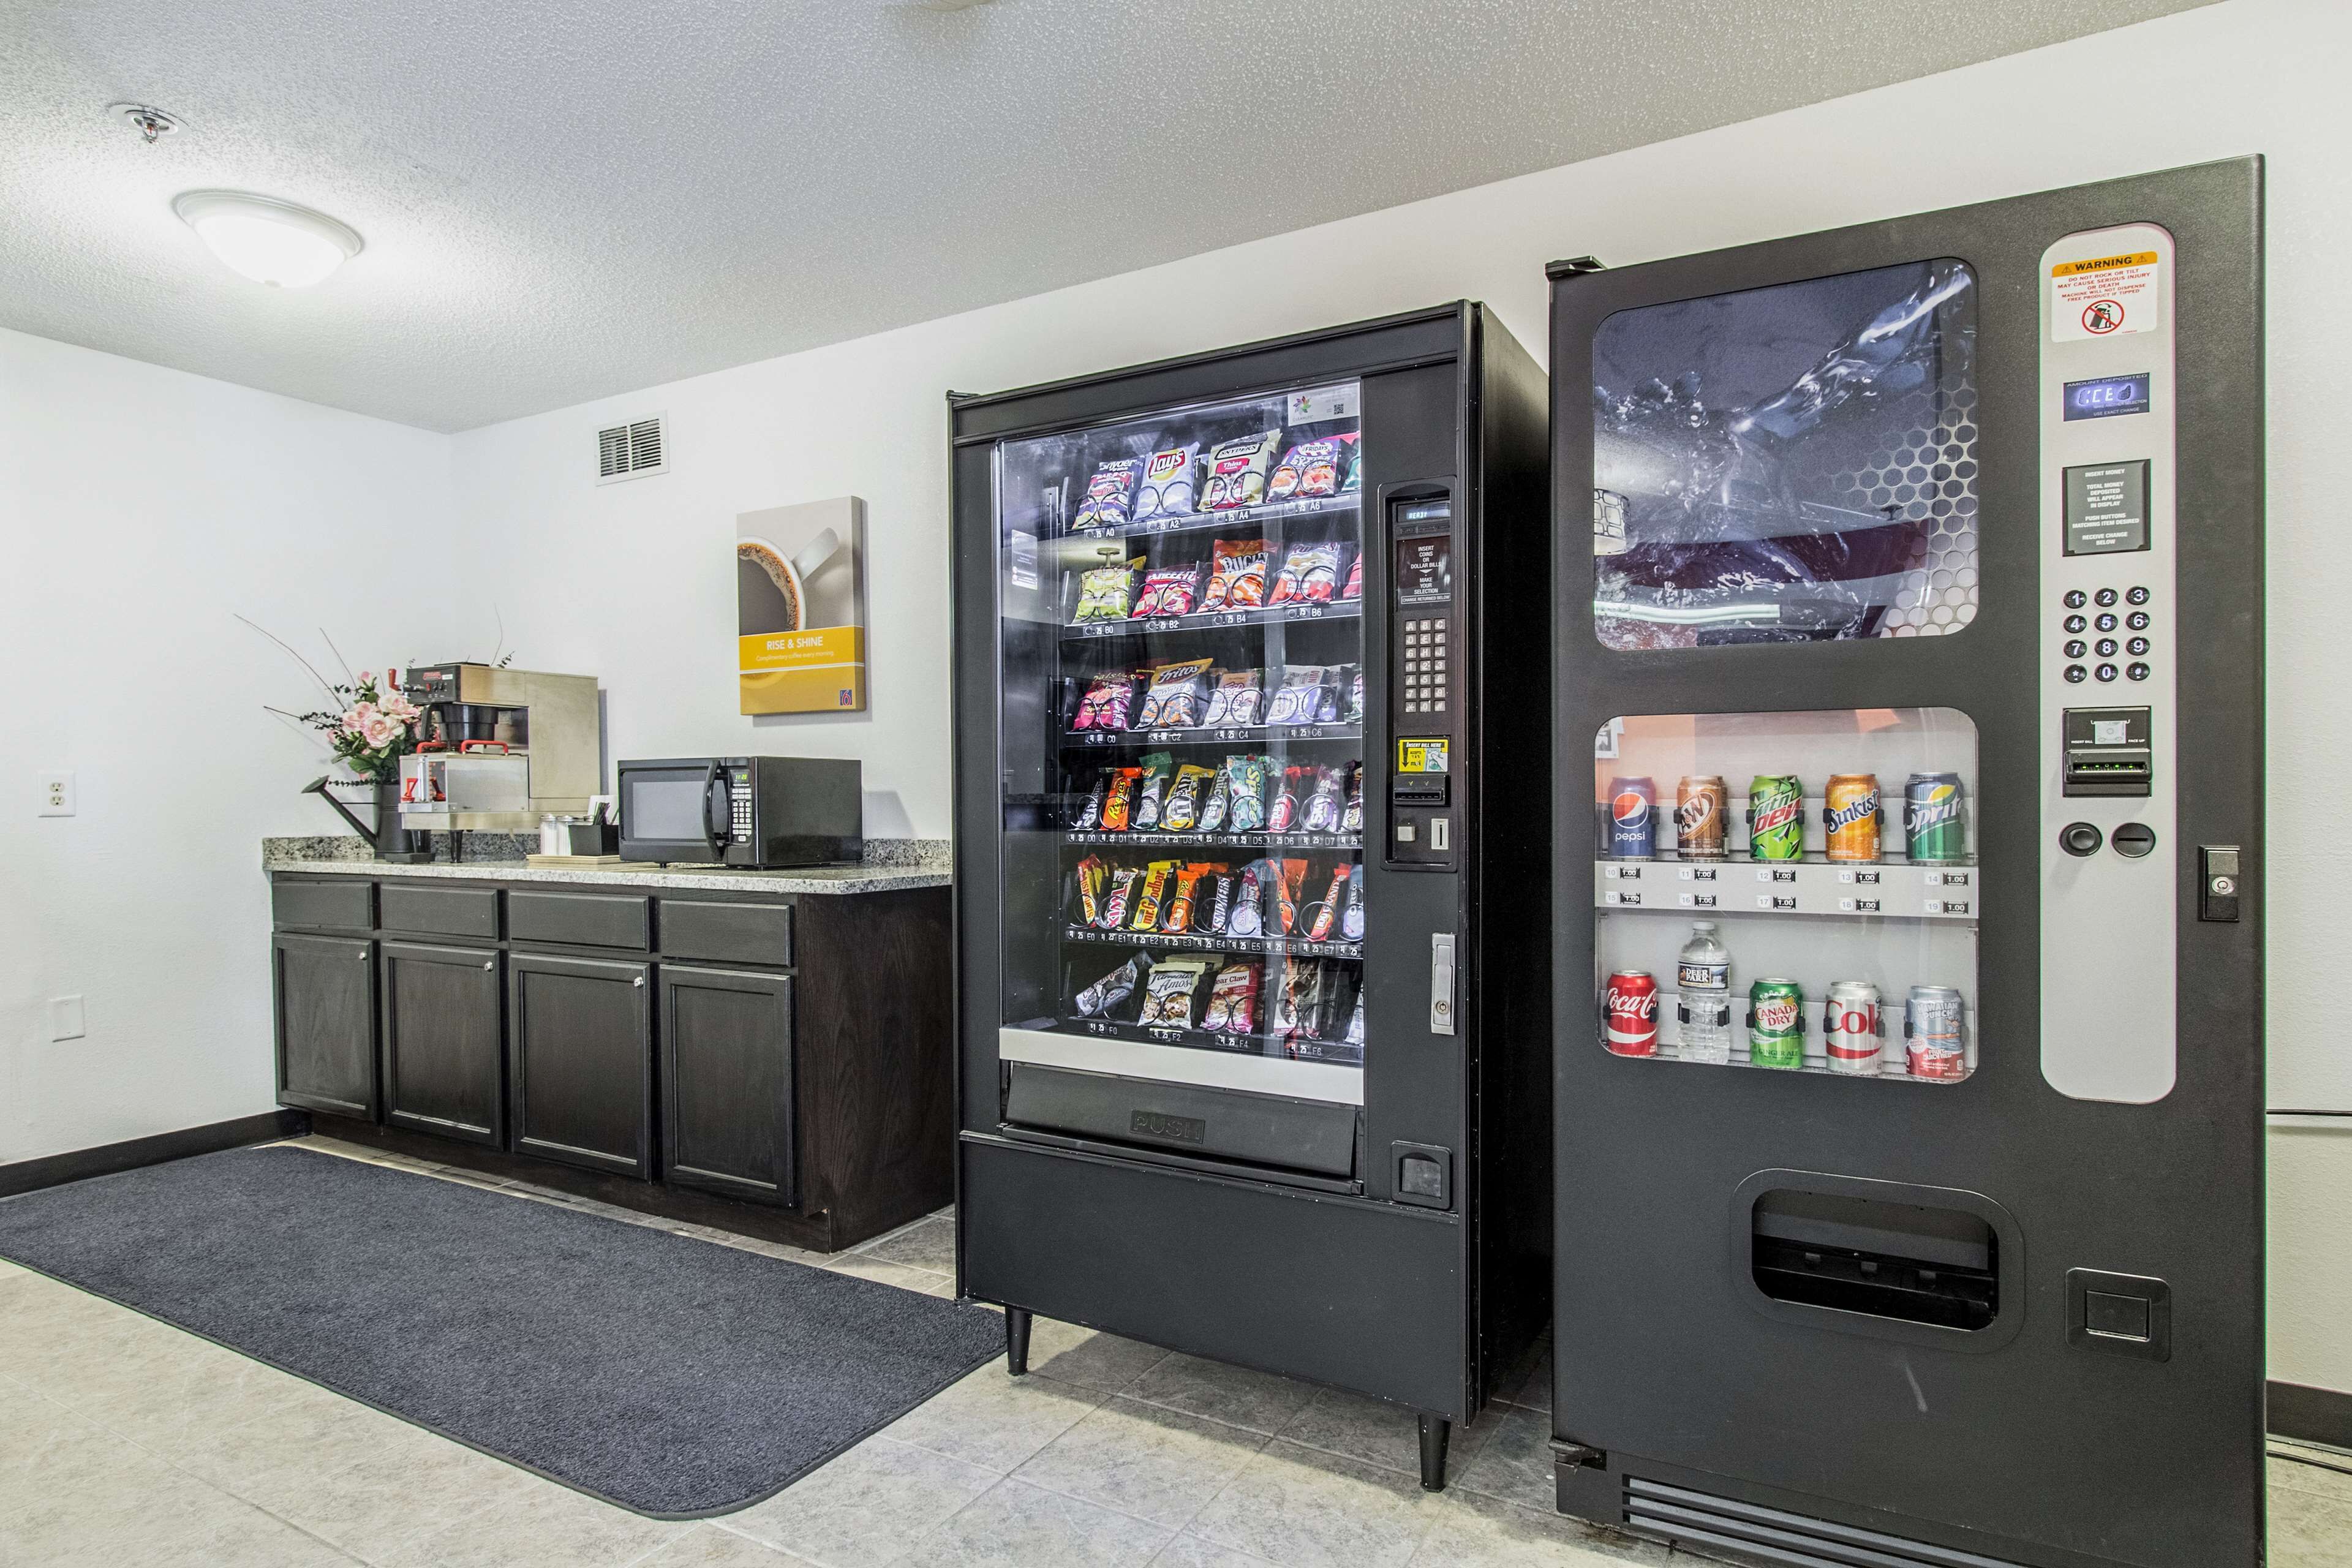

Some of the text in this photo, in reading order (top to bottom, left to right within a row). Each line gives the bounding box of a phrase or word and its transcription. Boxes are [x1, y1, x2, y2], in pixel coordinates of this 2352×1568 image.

[2075, 256, 2133, 271] WARNING
[2102, 374, 2147, 383] DEPOSITED
[1150, 452, 1183, 475] Lay's
[1238, 511, 1249, 519] A4
[1170, 521, 1180, 529] A2
[2072, 521, 2100, 529] MATCHING
[2071, 593, 2080, 605] 1
[2102, 591, 2112, 604] 2
[2133, 589, 2144, 601] 3
[1312, 608, 1322, 616] B6
[1237, 614, 1246, 623] B4
[2070, 617, 2080, 630] 4
[2101, 616, 2112, 628] 5
[2133, 615, 2144, 627] 6
[767, 636, 823, 650] RISE & SHINE
[2102, 642, 2112, 654] 8
[2133, 639, 2144, 652] 9
[2071, 643, 2081, 655] 7
[1158, 664, 1200, 684] Fritos
[2102, 666, 2112, 679] 0
[843, 690, 851, 706] 6
[1312, 728, 1322, 736] C6
[1827, 789, 1879, 834] Sunkist
[1118, 834, 1127, 843] D1
[1253, 837, 1262, 845] D5
[1284, 837, 1294, 845] D6
[1615, 831, 1645, 842] pepsi
[1349, 883, 1357, 916] OREO
[1087, 932, 1095, 941] E0
[1150, 936, 1158, 944] E2
[1183, 938, 1192, 946] E3
[1252, 942, 1261, 951] E5
[1324, 946, 1334, 954] E7
[1686, 968, 1708, 976] DEER
[1148, 971, 1194, 993] Famous Amos
[1755, 1004, 1798, 1020] CANADA
[1917, 1001, 1958, 1012] HAWAIIAN
[1923, 1010, 1953, 1019] PUNCH
[1768, 1014, 1790, 1027] DRY
[1109, 1027, 1117, 1035] F0
[1240, 1039, 1248, 1048] F4
[1134, 1116, 1202, 1140] PUSH
